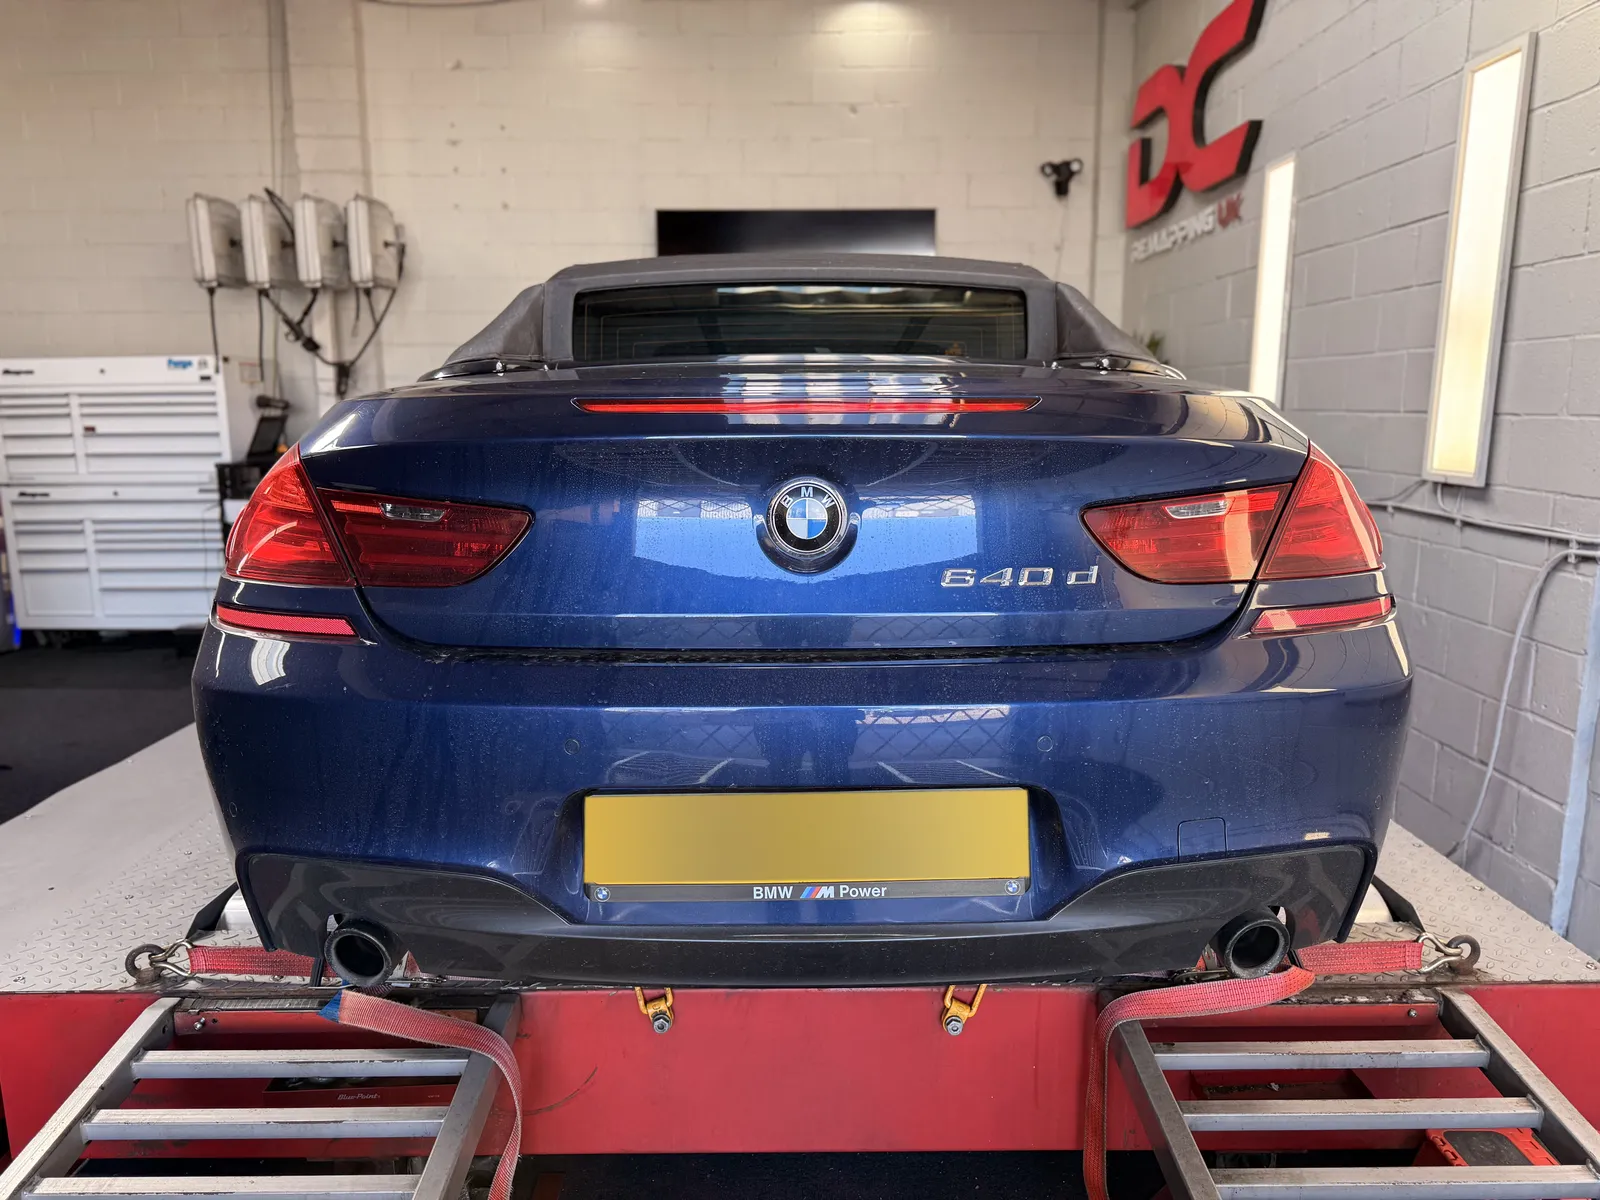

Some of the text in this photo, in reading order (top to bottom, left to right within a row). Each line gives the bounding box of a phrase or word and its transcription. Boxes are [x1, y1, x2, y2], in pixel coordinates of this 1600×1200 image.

[1125, 0, 1262, 230] DC
[1130, 192, 1243, 262] REMAPPING UK
[779, 486, 836, 509] BMW
[753, 886, 794, 899] BMW
[839, 885, 887, 898] Power
